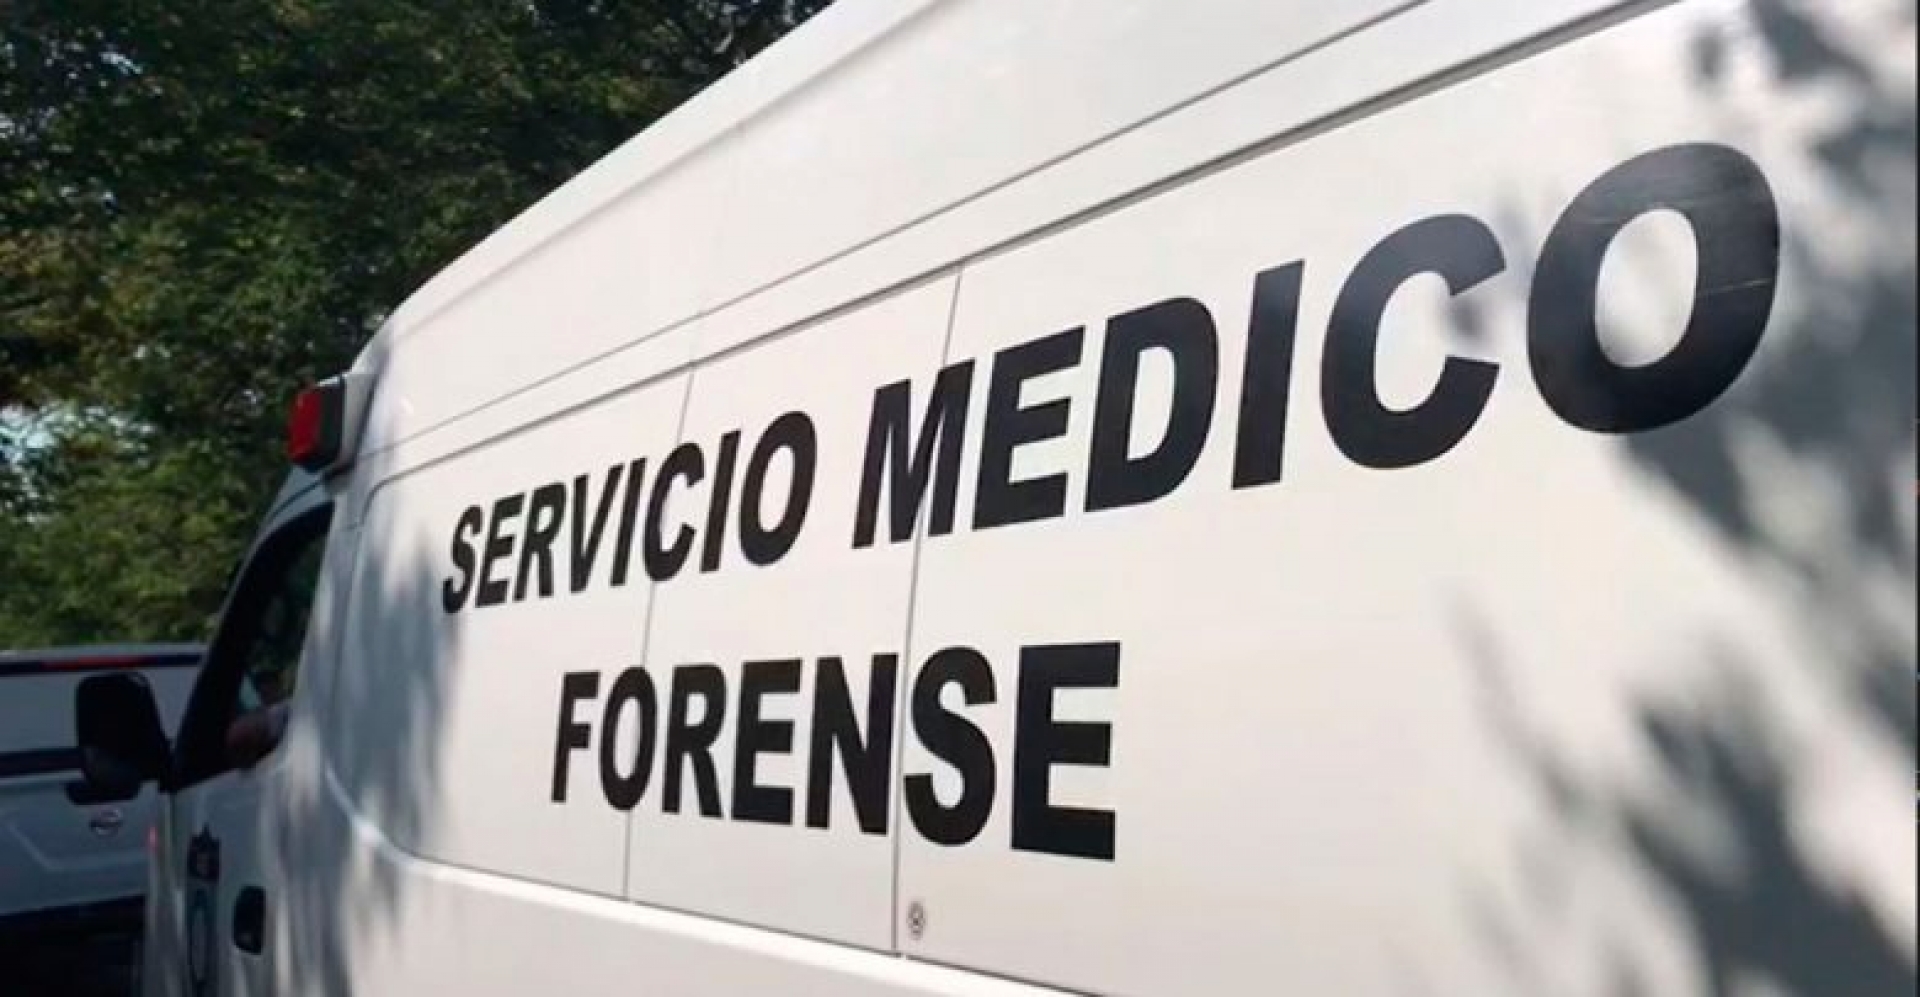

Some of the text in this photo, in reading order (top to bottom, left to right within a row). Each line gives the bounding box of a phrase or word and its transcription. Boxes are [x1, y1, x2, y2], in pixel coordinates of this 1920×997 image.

[441, 142, 1780, 615] SERVICIO MEDICO
[552, 641, 1121, 862] FORENSE
